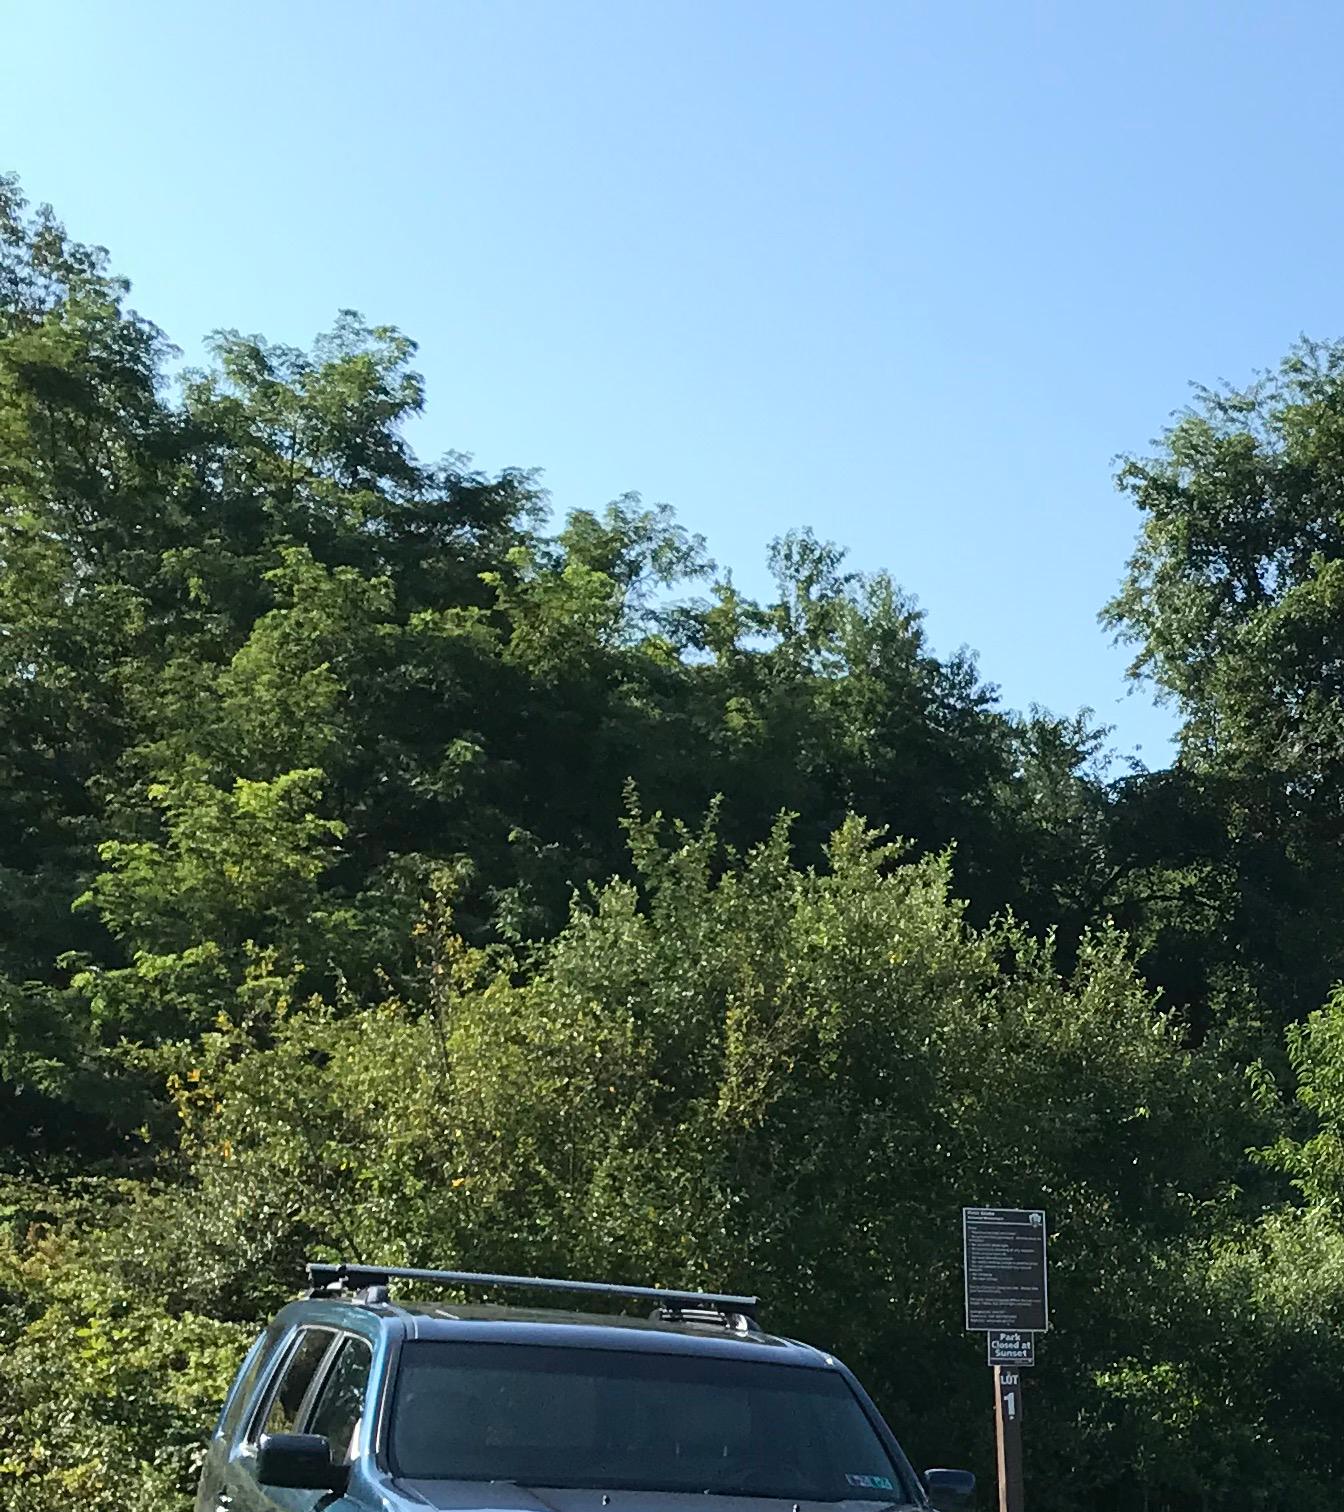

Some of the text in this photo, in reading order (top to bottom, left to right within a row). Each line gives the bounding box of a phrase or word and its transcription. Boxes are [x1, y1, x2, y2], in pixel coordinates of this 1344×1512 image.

[1000, 1333, 1021, 1341] Park
[991, 1340, 1019, 1349] Closed
[995, 1349, 1027, 1357] Sunset
[1000, 1374, 1019, 1385] LOT
[1003, 1392, 1016, 1415] 1
